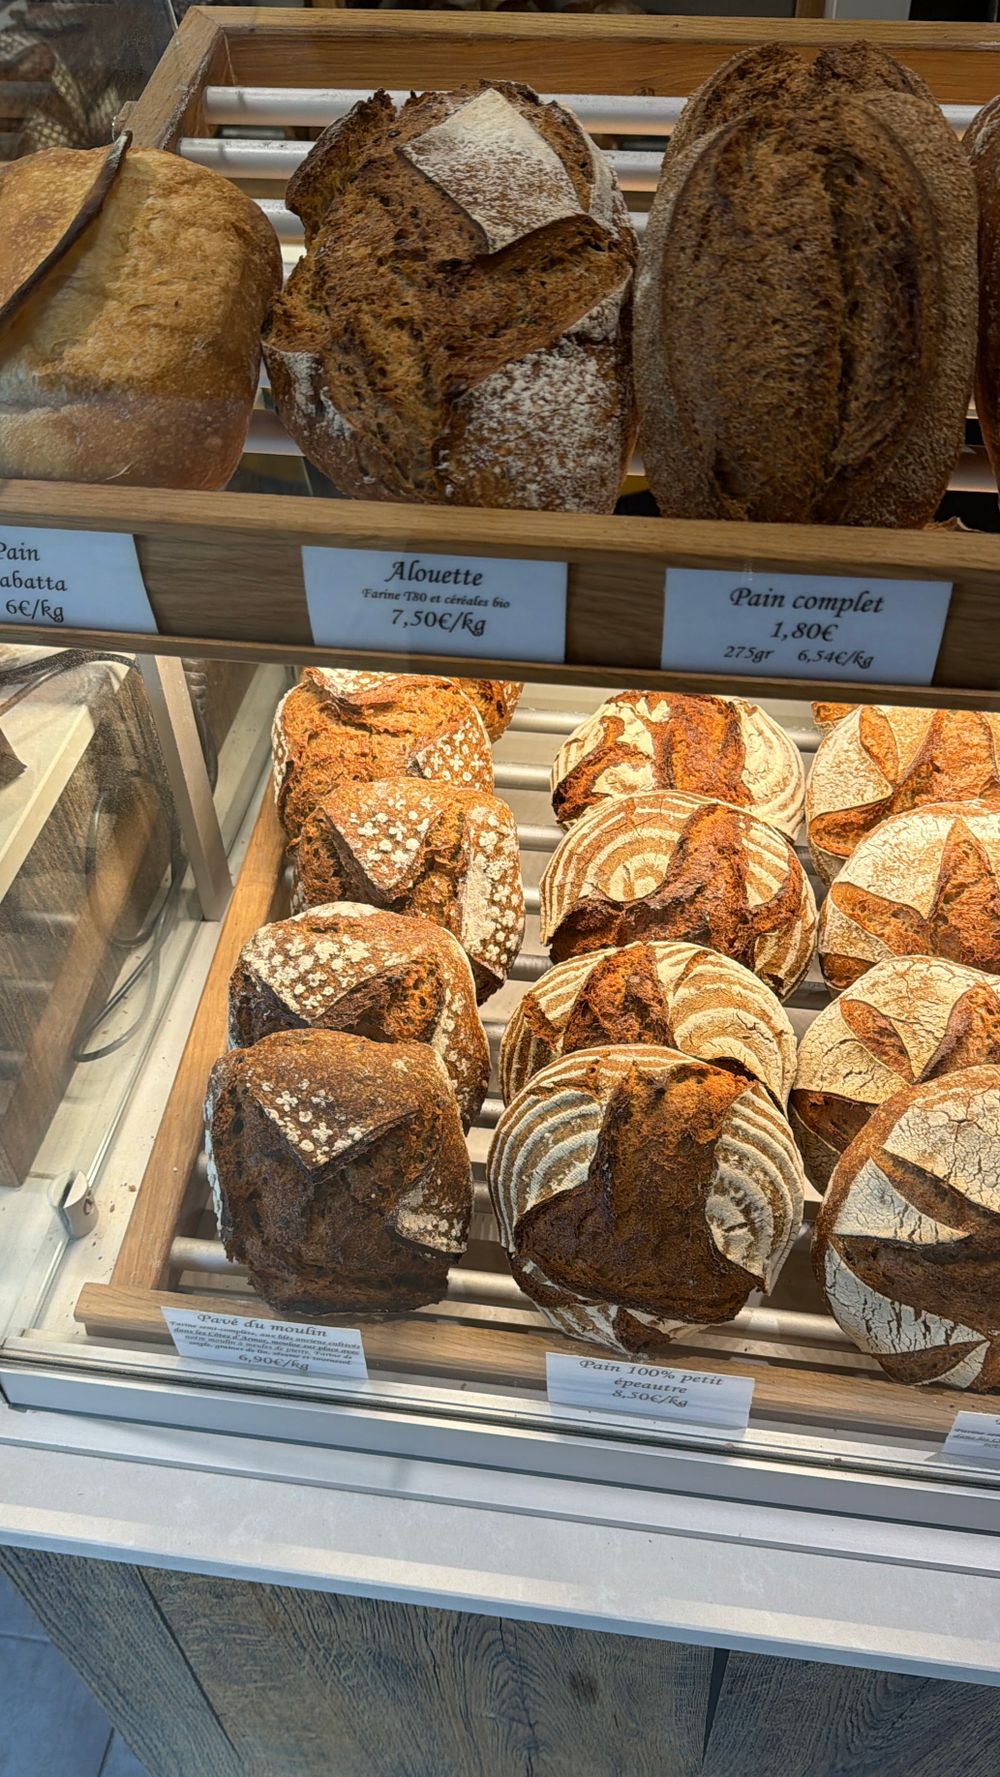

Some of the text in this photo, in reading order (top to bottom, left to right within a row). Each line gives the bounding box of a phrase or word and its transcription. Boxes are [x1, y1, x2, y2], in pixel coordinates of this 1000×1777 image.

[0, 541, 40, 561] ain
[384, 559, 483, 586] Alouette
[361, 588, 511, 609] Farine T80 et céréales bio
[729, 587, 884, 618] Pain complet
[5, 599, 65, 623] 6€/kg
[391, 608, 487, 637] 7,50€/kg
[770, 620, 839, 642] 1,80€
[723, 645, 875, 669] 275gr 6,54€/kg
[196, 1313, 328, 1337] Pavé du moulin
[237, 1352, 310, 1371] 6,90€/kg
[578, 1359, 724, 1386] Pain 100% petit
[613, 1376, 688, 1395] épeautre
[611, 1389, 689, 1408] 8,50€/kg
